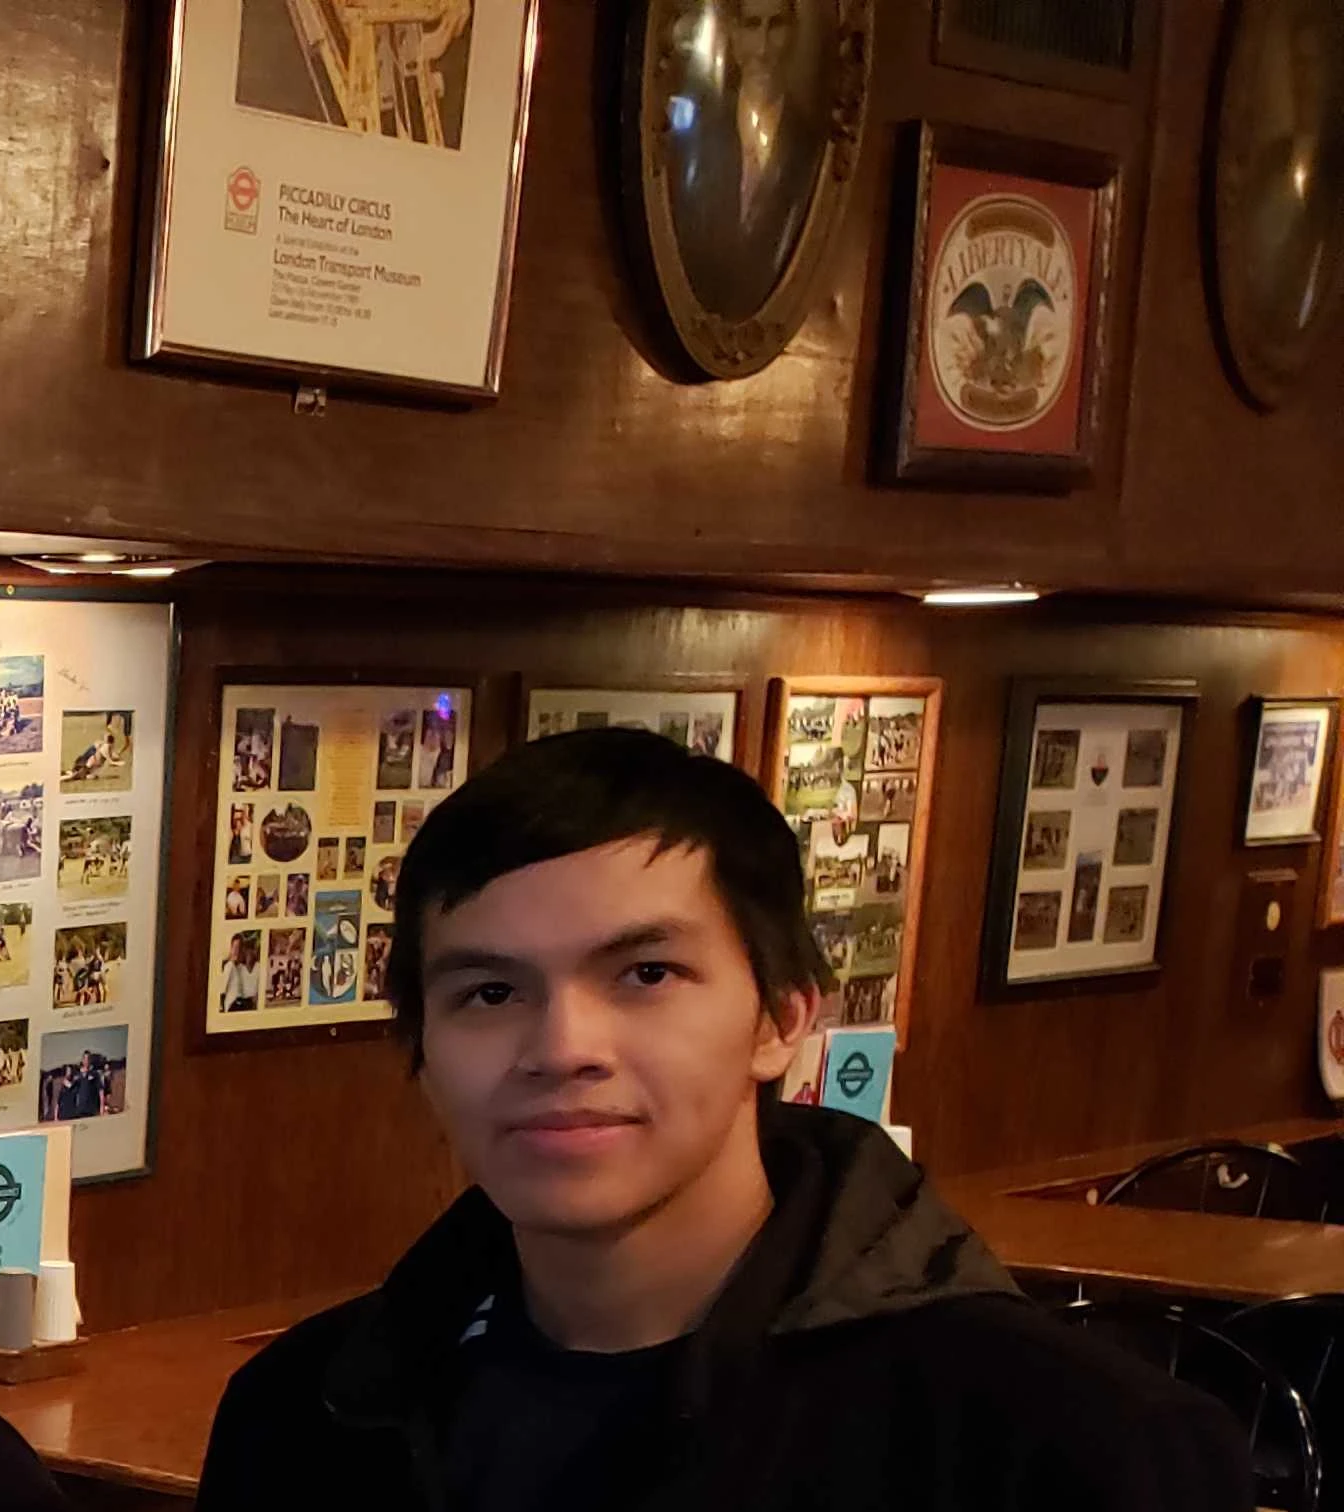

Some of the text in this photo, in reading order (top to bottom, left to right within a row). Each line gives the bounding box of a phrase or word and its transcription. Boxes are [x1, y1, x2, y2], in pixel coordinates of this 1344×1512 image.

[279, 184, 391, 220] PICCADILLY CIRCUS
[278, 206, 299, 225] The
[301, 212, 333, 231] Heart
[336, 219, 349, 233] of
[351, 222, 393, 241] London
[273, 248, 421, 287] London Transport Museum
